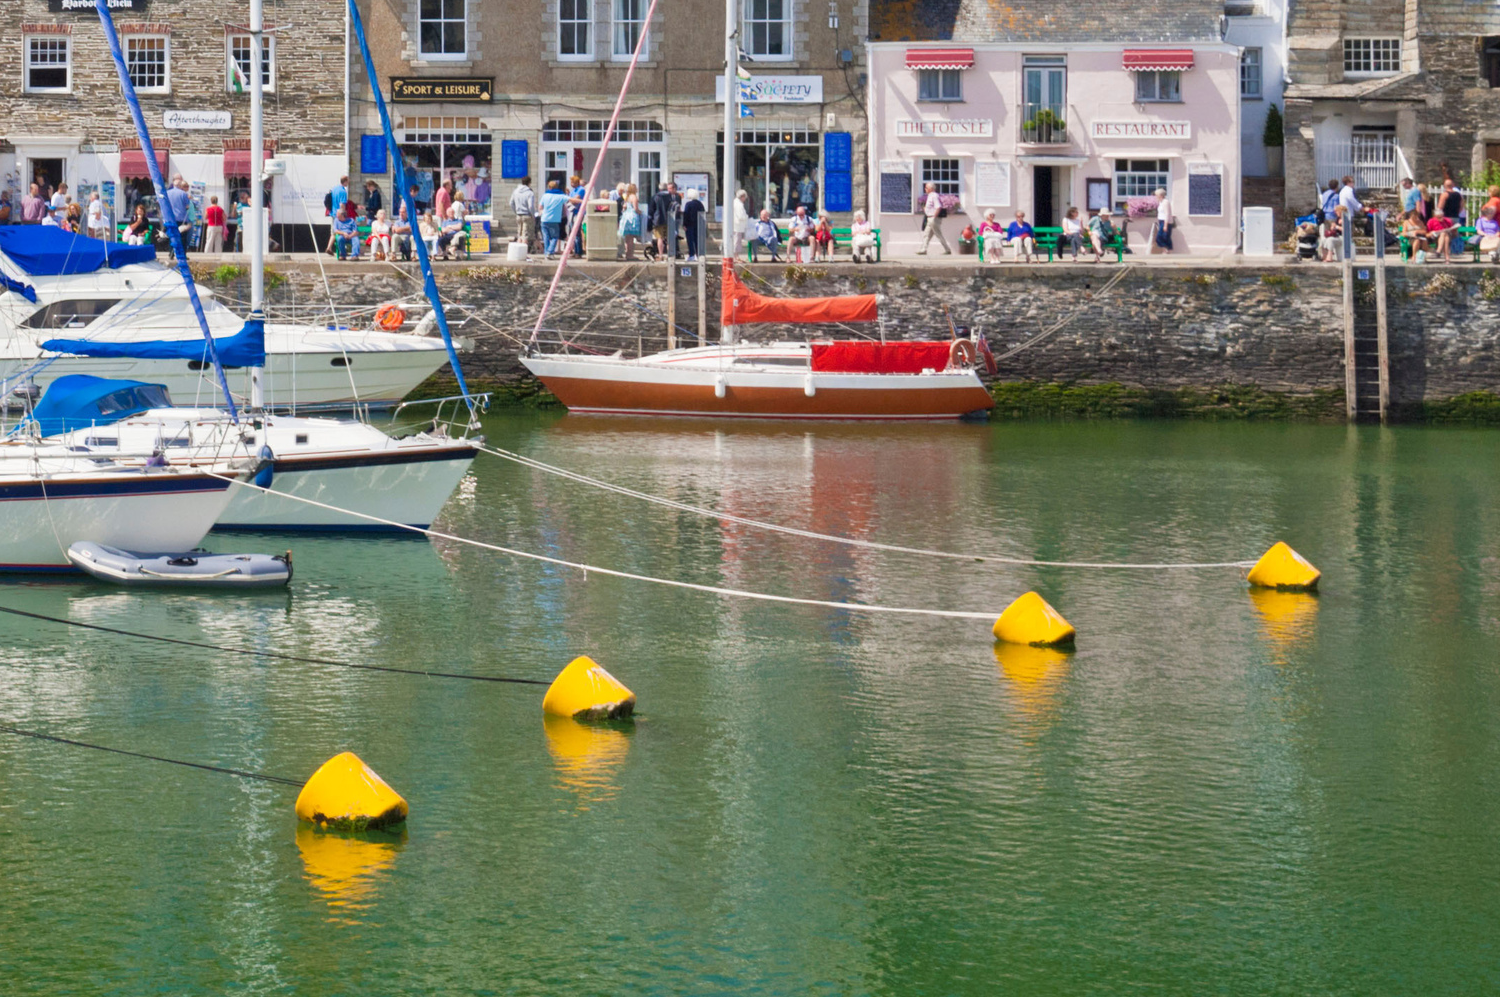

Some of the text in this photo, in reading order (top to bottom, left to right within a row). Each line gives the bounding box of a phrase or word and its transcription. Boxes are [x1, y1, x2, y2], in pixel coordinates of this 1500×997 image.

[402, 85, 481, 94] SPORT & LEISURE
[169, 113, 226, 126] Afterthoughts
[903, 121, 927, 134] THE
[1096, 123, 1187, 135] RESTAURANT
